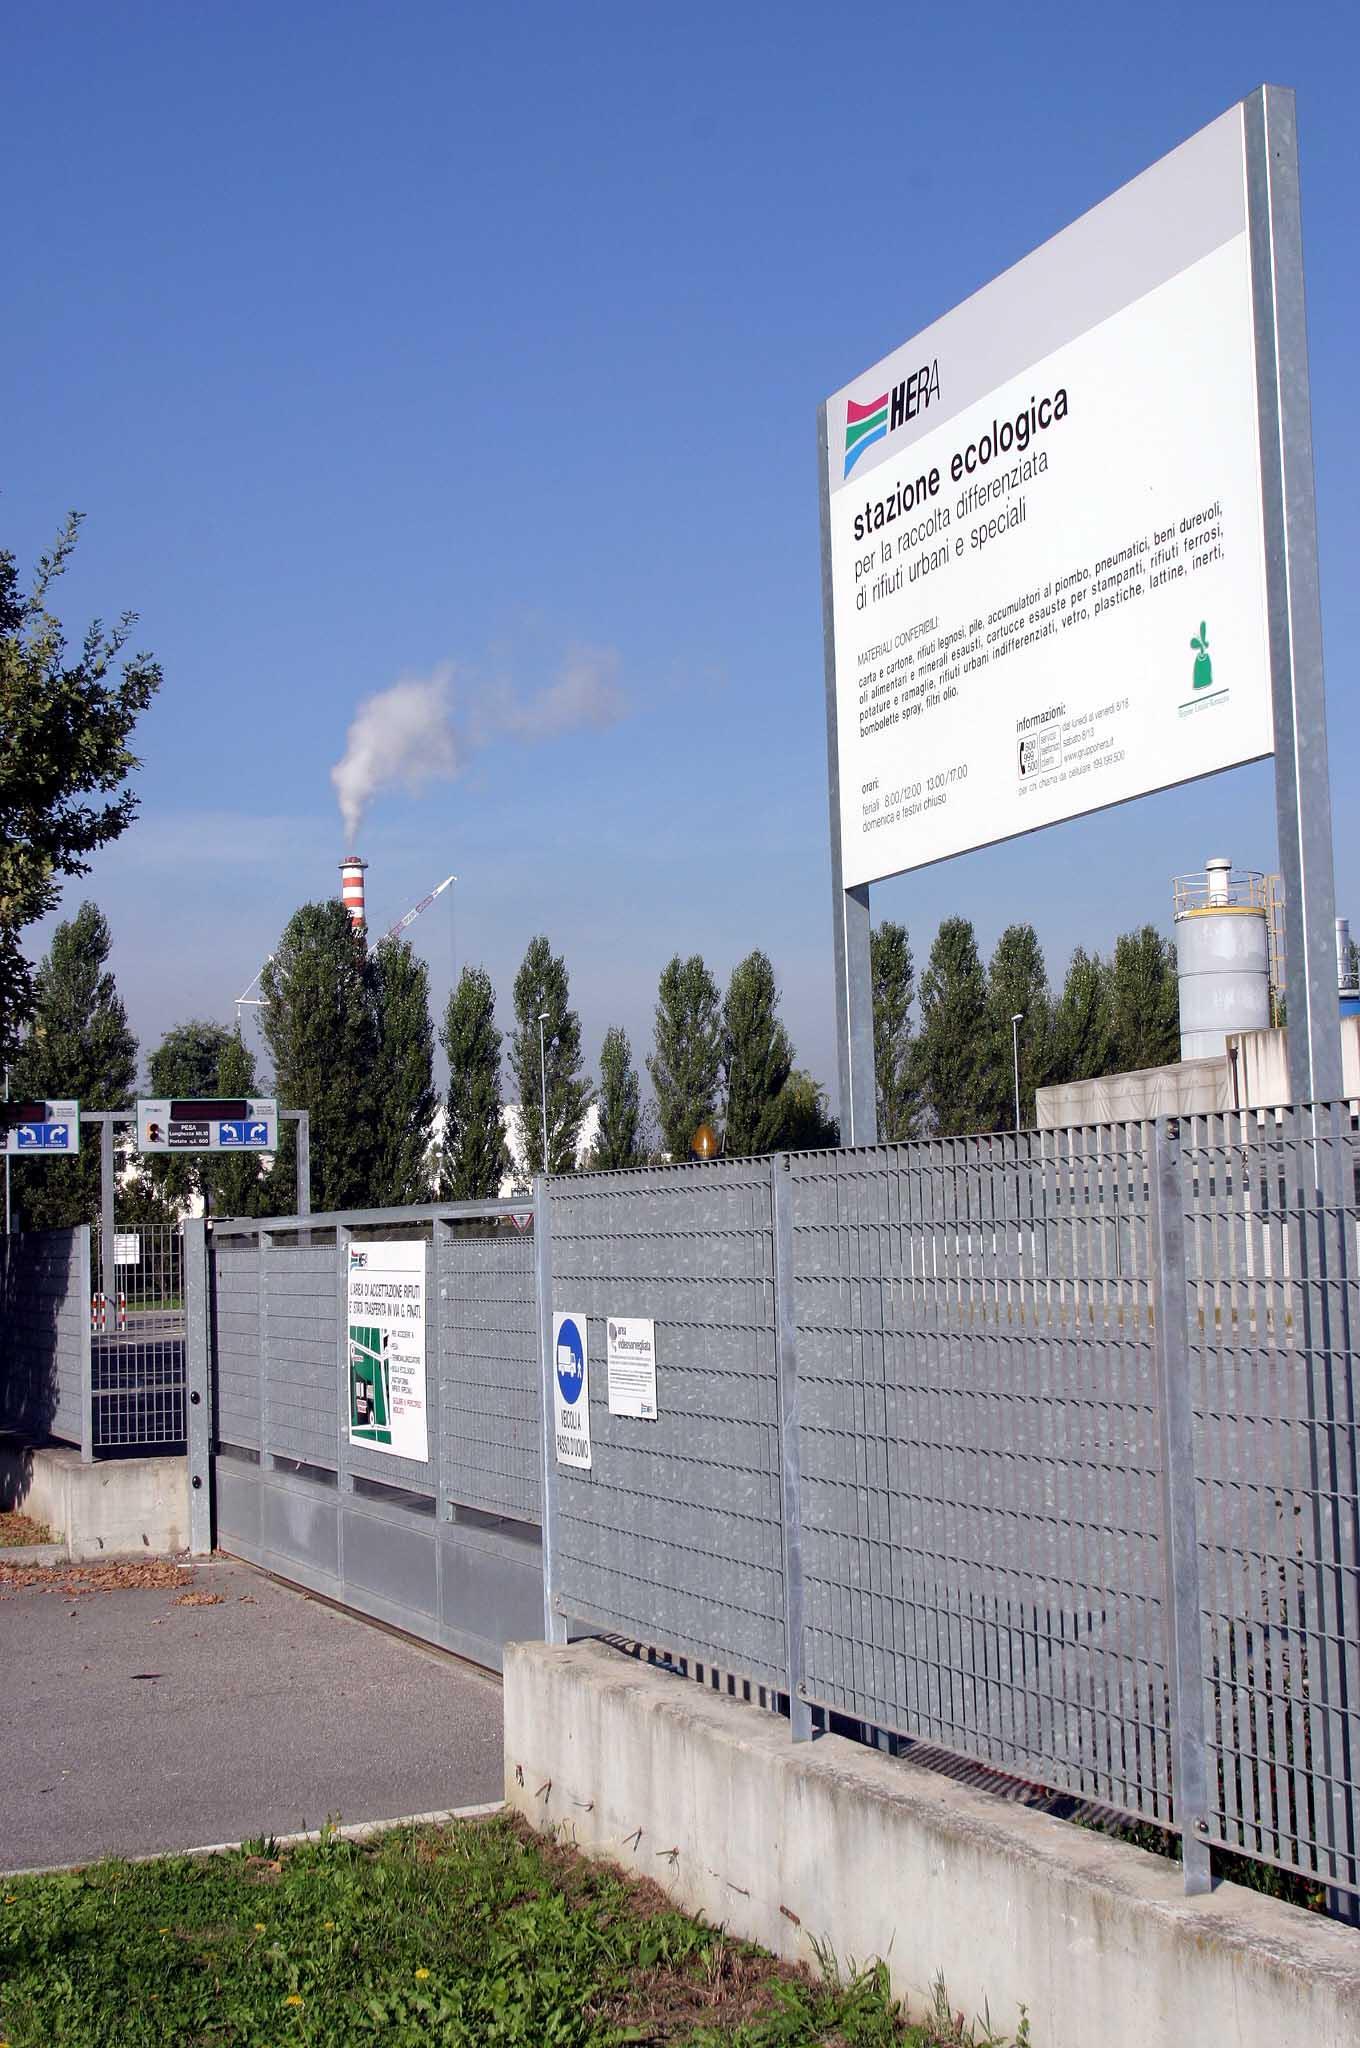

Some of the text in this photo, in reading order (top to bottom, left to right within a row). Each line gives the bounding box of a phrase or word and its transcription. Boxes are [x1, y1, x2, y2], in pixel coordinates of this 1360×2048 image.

[890, 359, 941, 432] HERA
[853, 388, 1068, 541] stazione ecologica
[854, 451, 1049, 584] per la raccolta differenziata
[856, 495, 1026, 611] di rifiuti urbani e speciali
[858, 500, 1223, 689] carta e cartone, rifiuti legnosi, pile, accumulatori al piombo, pneumatici, beni durevoli,
[858, 522, 1224, 705] oli alimentari e minerali esausti, cartucce esauste per stampanti, rifiuti ferrosi,
[857, 639, 893, 666] MATERIALI
[859, 543, 1225, 724] potature e ramaglie, rifiuti urbani indifferenziati, vetro, plastiche, lattine, inerti,
[859, 685, 959, 738] bombolette spray, filtri olio.
[1016, 701, 1066, 733] informazioni:
[862, 812, 895, 833] domenica
[895, 809, 901, 821] e
[922, 792, 947, 811] chiuso
[353, 1301, 363, 1314] STATA
[364, 1302, 386, 1316] TRASFERITA
[388, 1303, 391, 1317] IN
[364, 1283, 369, 1297] DI
[370, 1283, 402, 1298] ACCETTAZIONE
[404, 1285, 421, 1299] RIFIUTI
[617, 1327, 627, 1335] area
[561, 1409, 582, 1431] VEICOLI A
[557, 1434, 570, 1455] PASSO
